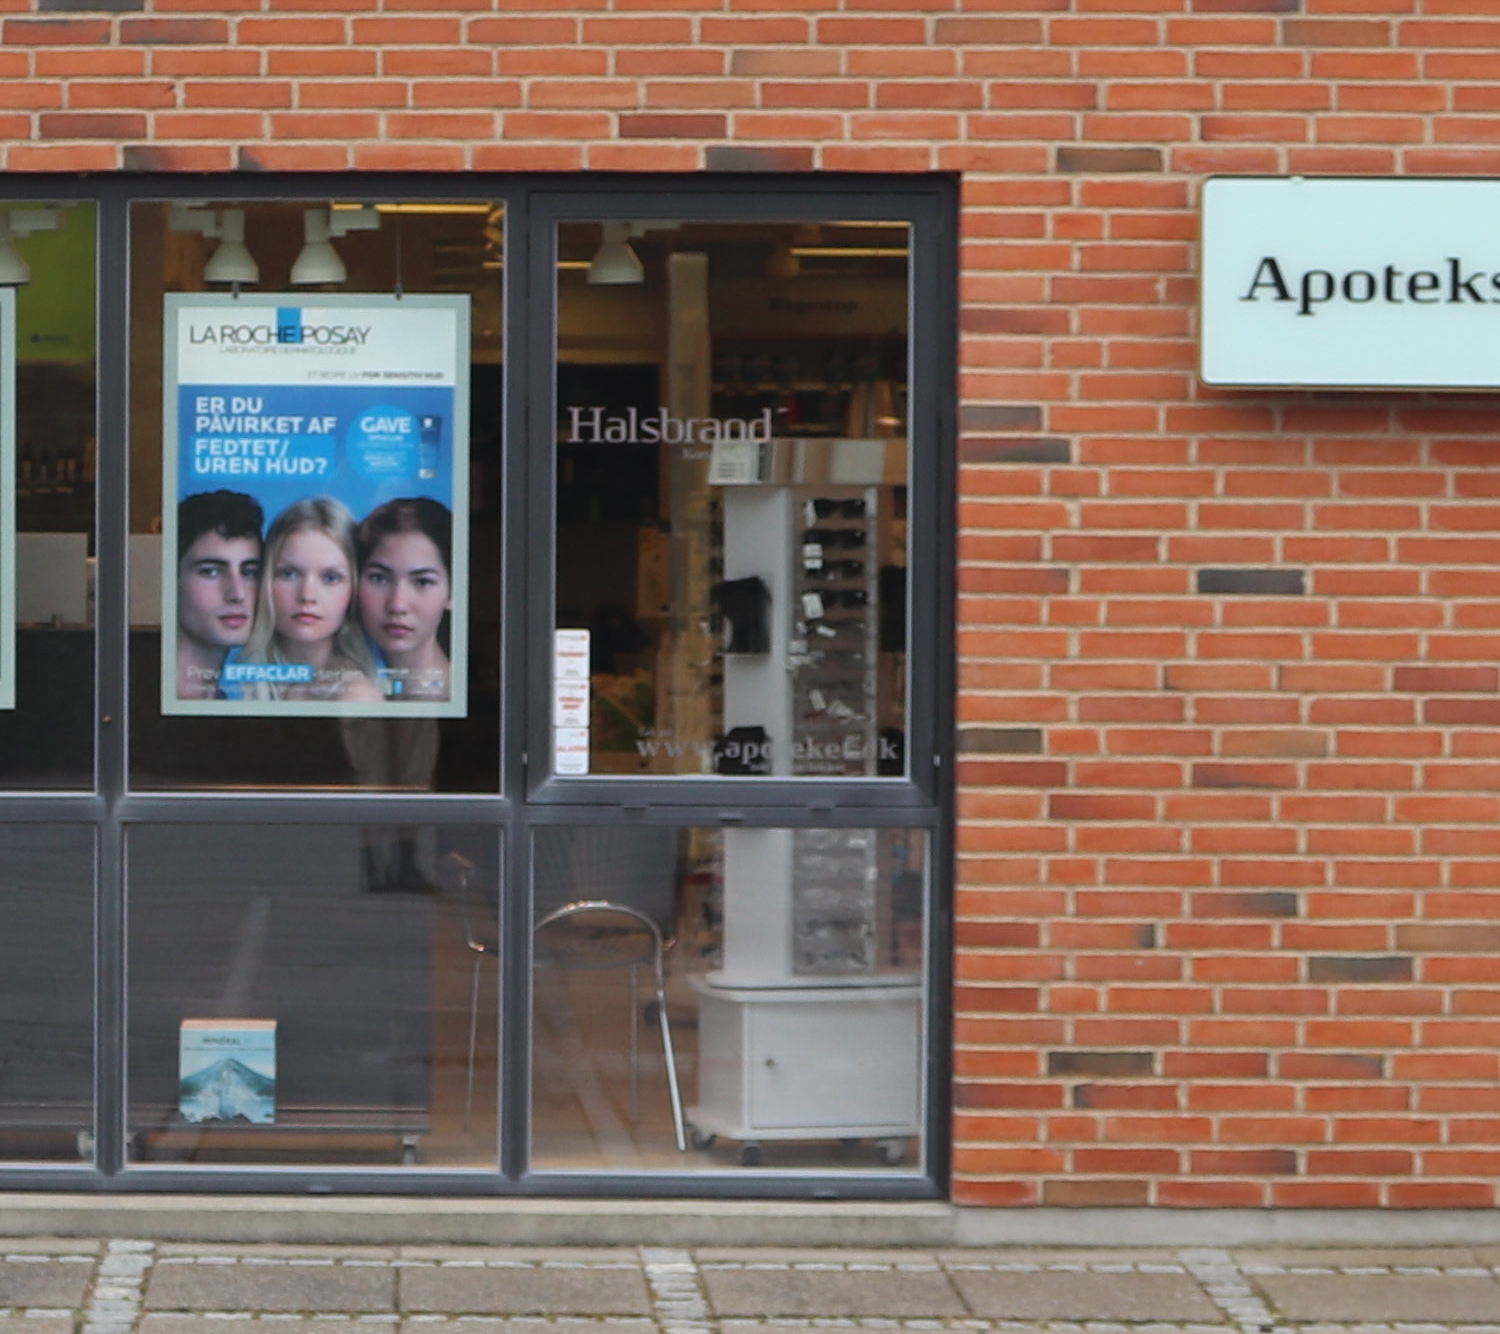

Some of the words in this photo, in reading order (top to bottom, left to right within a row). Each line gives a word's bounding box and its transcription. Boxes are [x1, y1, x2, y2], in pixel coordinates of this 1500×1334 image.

[189, 326, 217, 345] LA
[301, 326, 371, 345] POSAY
[195, 397, 225, 414] ER
[231, 397, 263, 414] DU
[195, 412, 304, 434] PÅVIRKET
[307, 416, 337, 434] AF
[359, 416, 412, 433] GAVE
[566, 406, 772, 444] Halsbrand
[195, 438, 290, 457] FEDTET/
[194, 457, 260, 474] UREN
[265, 457, 328, 474] HUD?
[187, 668, 219, 680] Prøv
[225, 667, 310, 680] EFFACLAR
